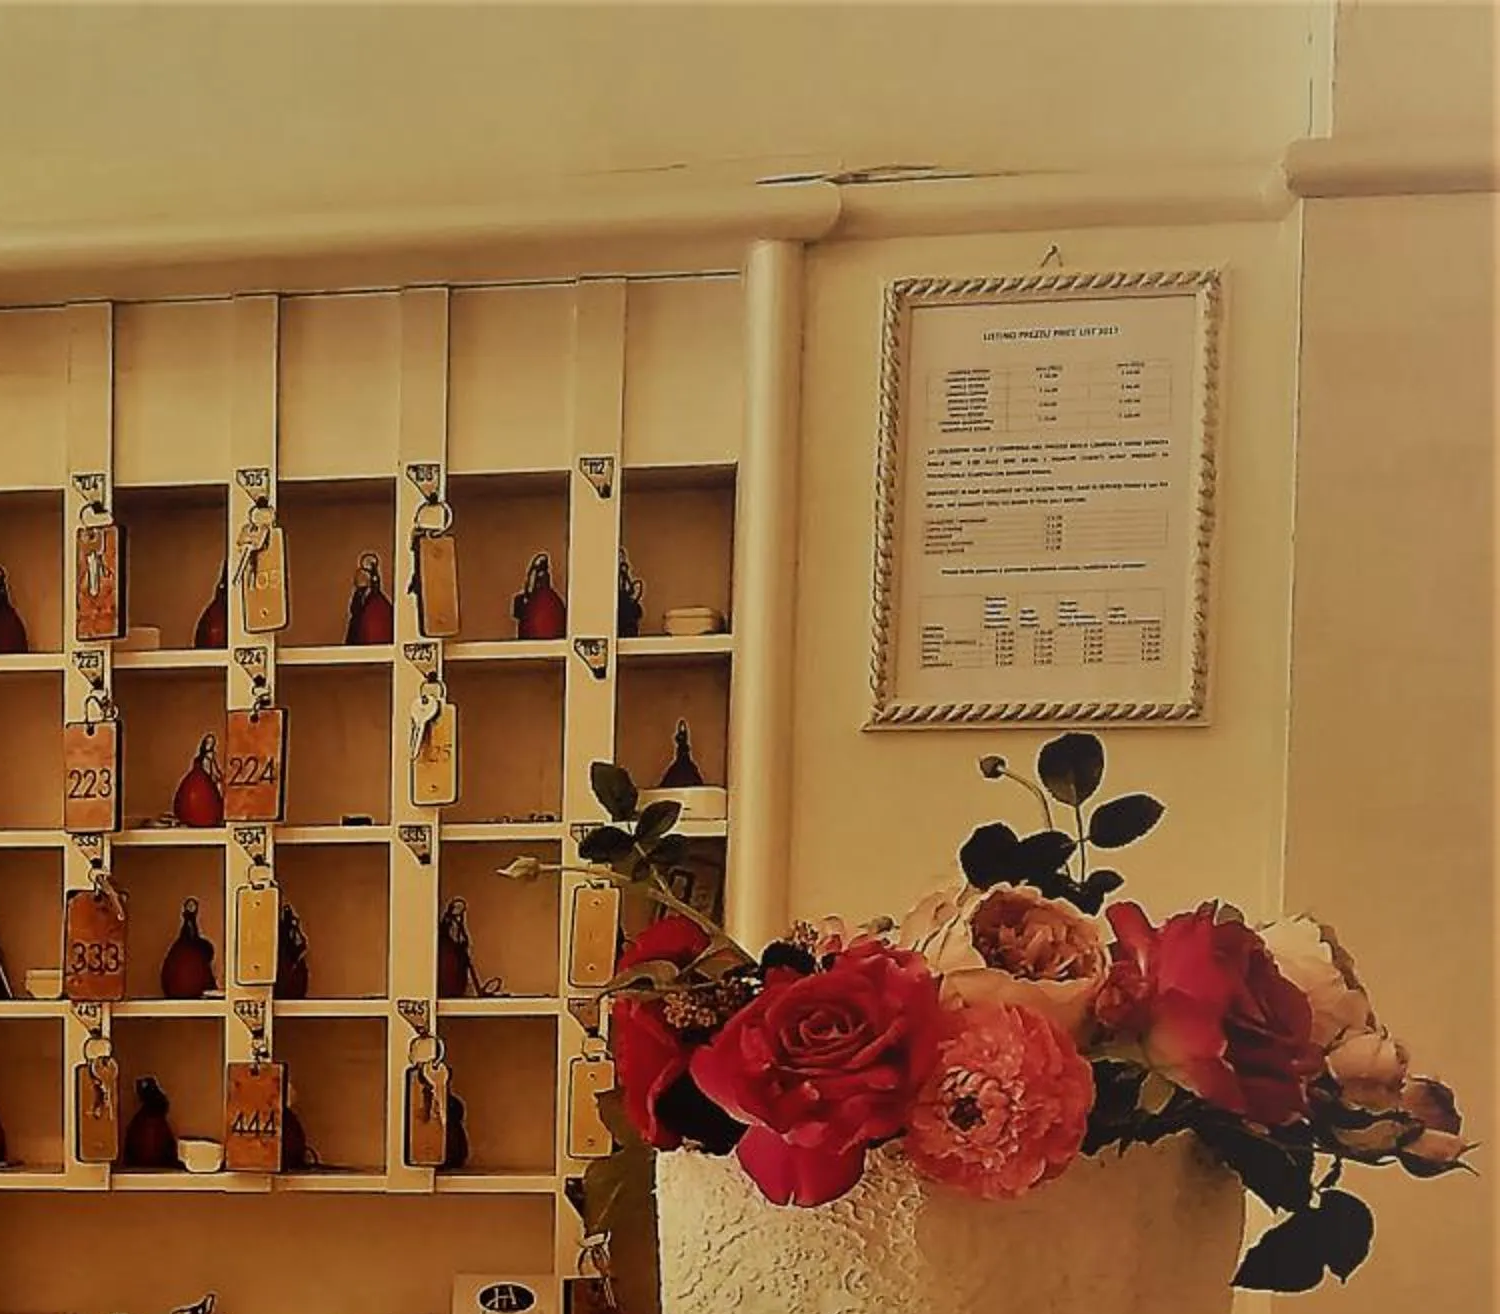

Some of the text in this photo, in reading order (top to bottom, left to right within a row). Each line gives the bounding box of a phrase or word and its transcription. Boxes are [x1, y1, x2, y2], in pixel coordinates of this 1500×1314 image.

[239, 650, 261, 665] 224
[68, 768, 112, 799] 223
[228, 755, 276, 787] 224
[72, 942, 119, 973] 333
[232, 1109, 277, 1136] 444
